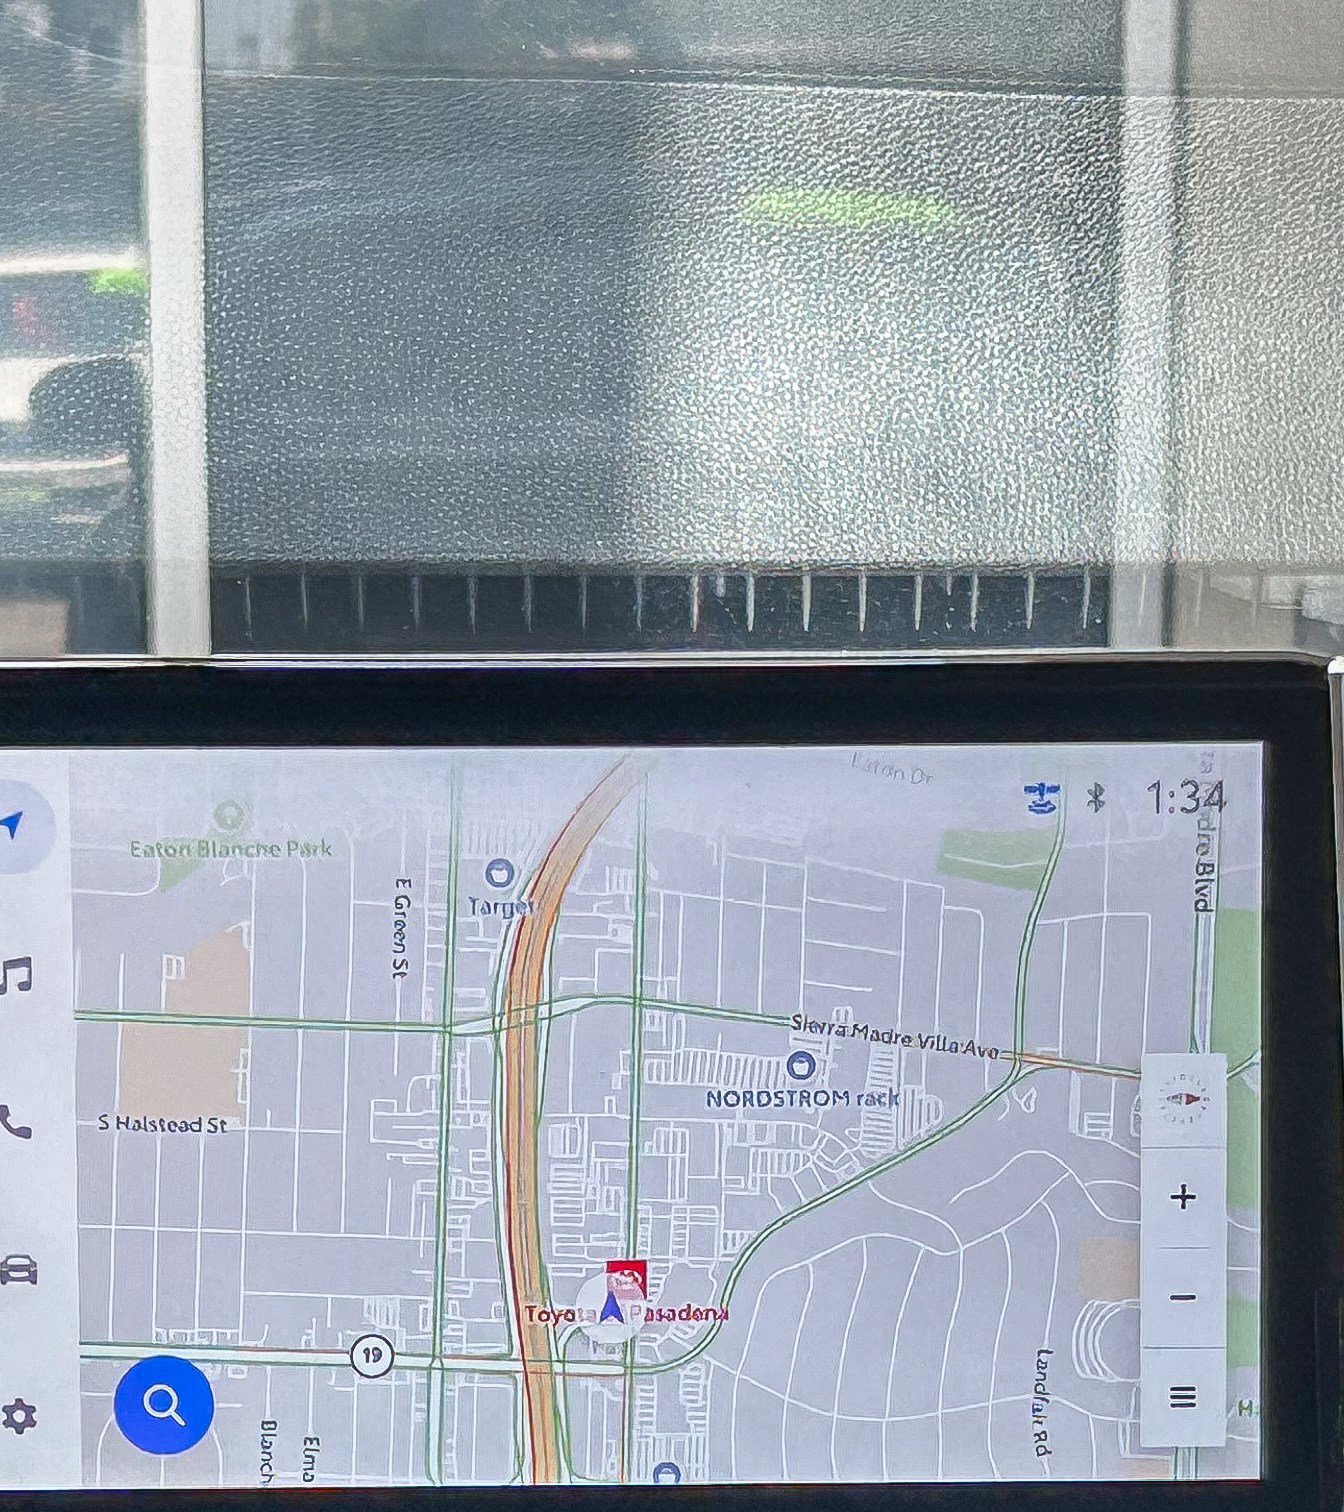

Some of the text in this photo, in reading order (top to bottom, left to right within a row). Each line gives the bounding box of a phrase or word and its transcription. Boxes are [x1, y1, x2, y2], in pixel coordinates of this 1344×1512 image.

[1147, 779, 1227, 814] 1:34
[130, 837, 334, 859] Eaton Blanche Park
[1194, 861, 1216, 913] Blvd
[392, 878, 412, 980] E Green St
[791, 1013, 847, 1039] Sierra
[852, 1023, 914, 1049] Madre
[917, 1032, 961, 1054] Villa
[706, 1087, 902, 1109] NORDSTROM rack
[98, 1113, 228, 1134] S Halstead St
[362, 1346, 383, 1364] 19
[302, 1436, 321, 1483] Elma
[1033, 1430, 1053, 1458] Rd
